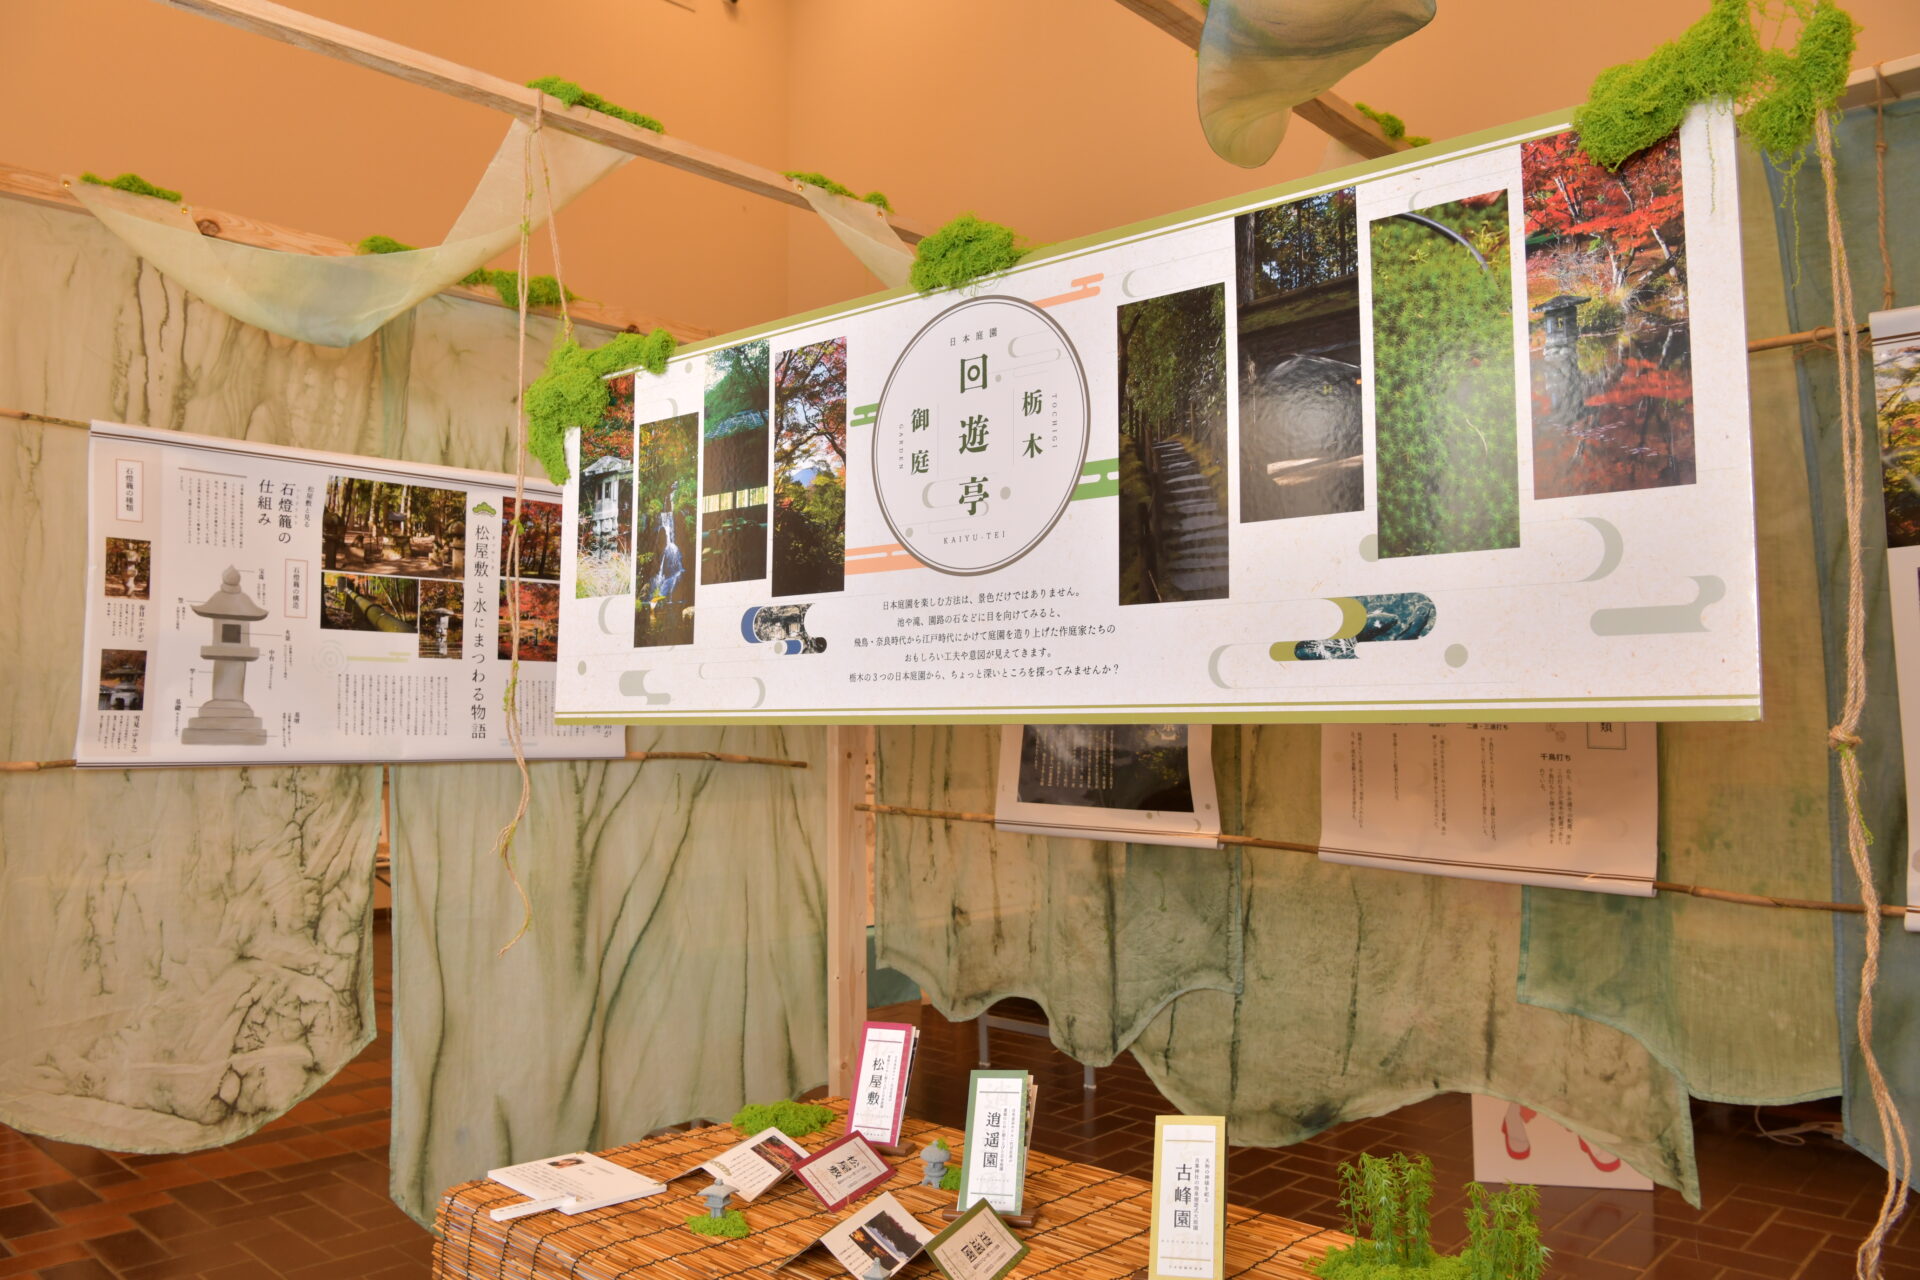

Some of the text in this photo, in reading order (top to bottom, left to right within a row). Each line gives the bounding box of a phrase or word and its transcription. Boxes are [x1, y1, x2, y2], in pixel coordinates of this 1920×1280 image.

[949, 327, 998, 346] 日本庭園
[911, 407, 931, 476] 御庭
[958, 353, 990, 516] 回遊亭
[1021, 389, 1043, 459] 栃木
[257, 479, 274, 526] 仕組み
[278, 482, 296, 544] 石燈籠の
[882, 587, 1081, 611] 日本庭園を楽しむ方法は、景色だけではありません。
[897, 607, 1062, 628] 池や滝、園路の石などに目を向けてみると、
[471, 524, 489, 739] 松屋敷と水にまつわる物語
[854, 624, 1116, 648] 飛鳥・奈良時代から江戸時代にかけて庭園を造り上げた作庭家たちの
[904, 647, 1052, 663] おもしろい工夫や意図が見えてきます。
[1540, 753, 1571, 762] 千鳥打ち
[866, 1057, 885, 1105] 松屋敷
[983, 1111, 1001, 1168] 逍遥園
[1174, 1163, 1193, 1229] 古峰園
